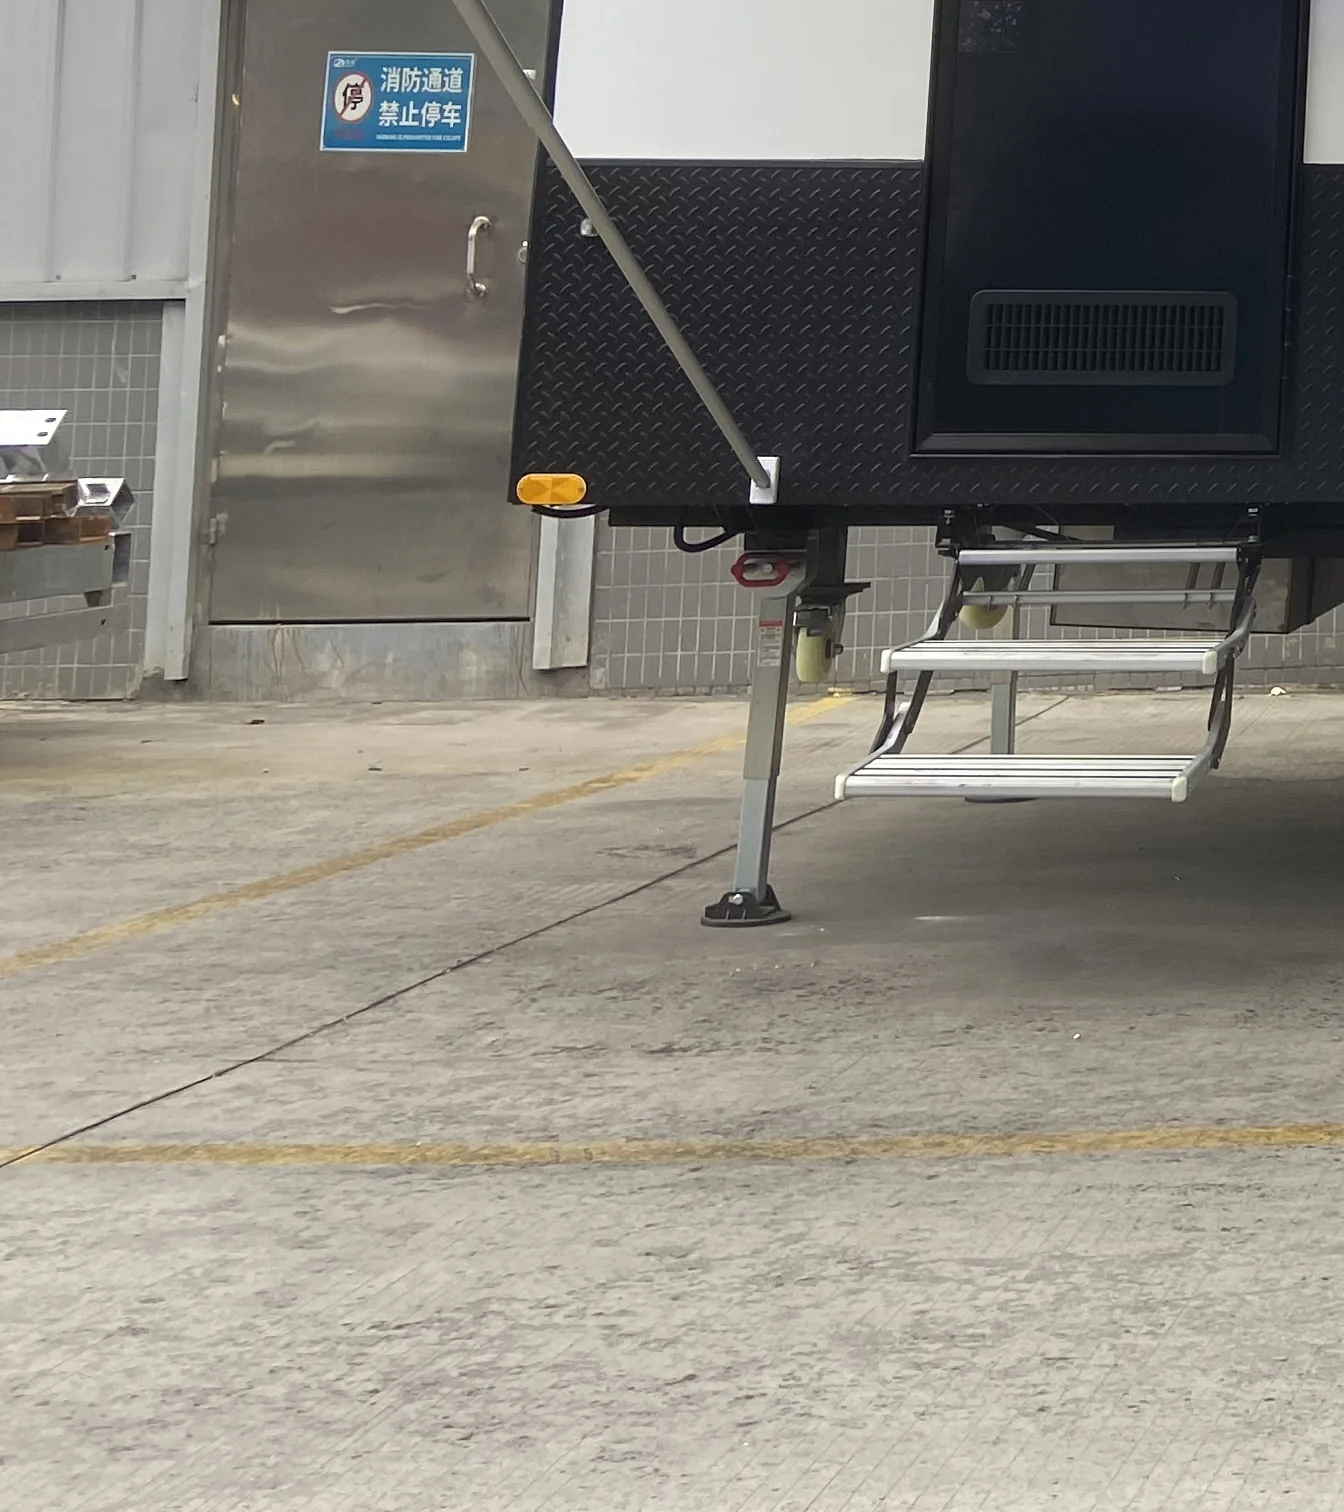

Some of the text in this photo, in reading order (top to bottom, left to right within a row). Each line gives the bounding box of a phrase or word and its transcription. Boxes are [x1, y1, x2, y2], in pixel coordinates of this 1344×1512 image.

[380, 66, 463, 93] 消防通道
[378, 100, 462, 128] 禁止停车
